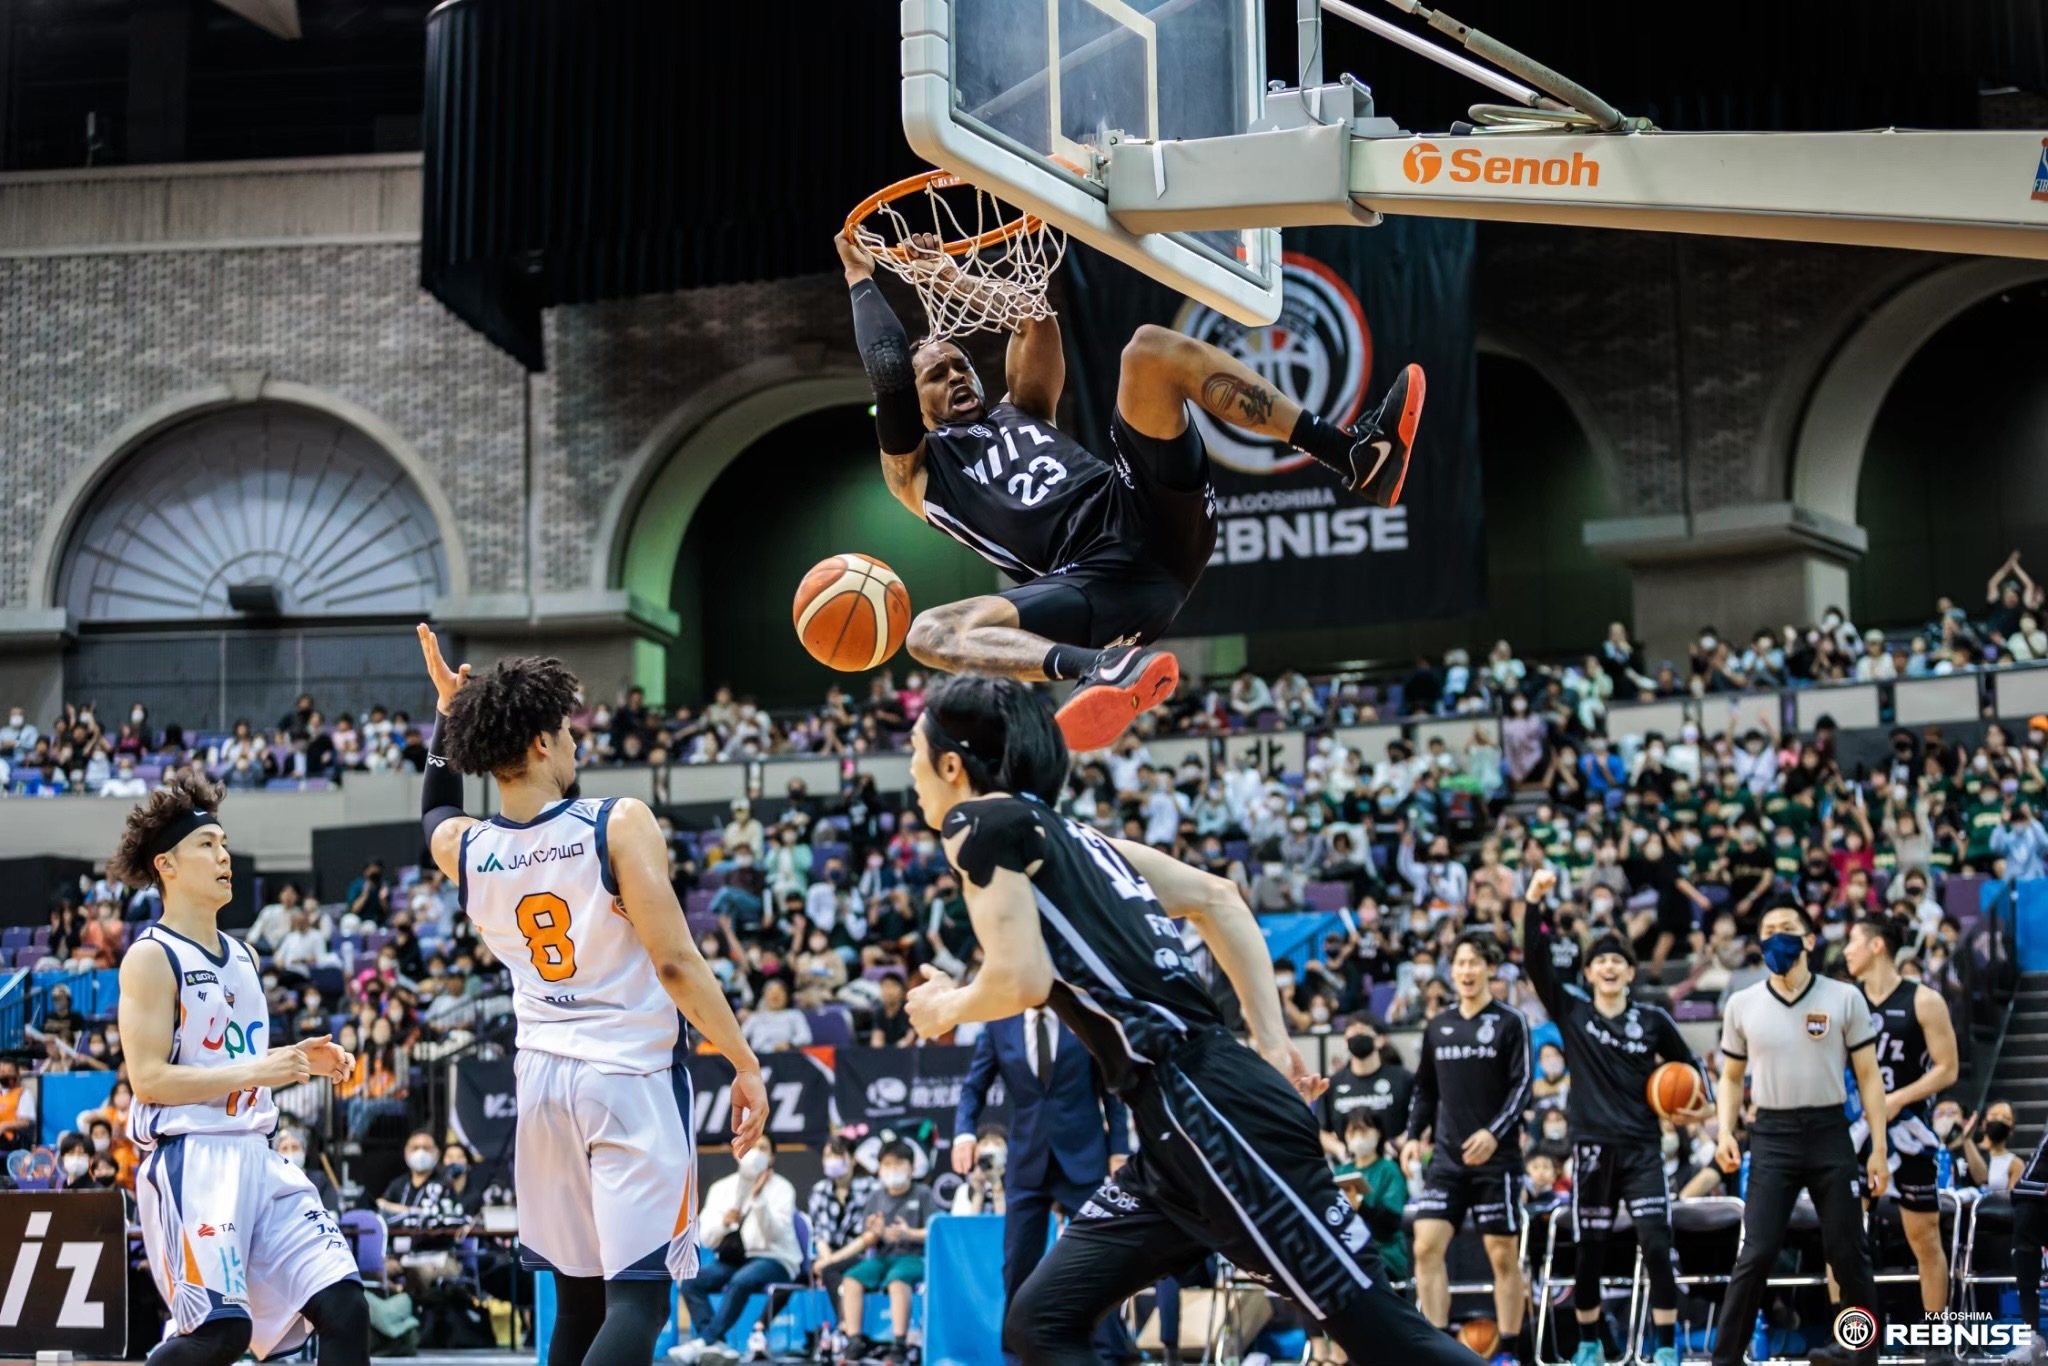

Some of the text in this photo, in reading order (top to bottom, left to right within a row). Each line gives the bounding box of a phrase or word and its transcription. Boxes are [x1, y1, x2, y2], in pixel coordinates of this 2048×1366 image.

[1448, 148, 1600, 187] Senoh
[1008, 456, 1067, 507] 23
[1216, 487, 1337, 513] KAGOSHIMA
[508, 842, 585, 870] JAバンク山口
[515, 891, 577, 983] 8
